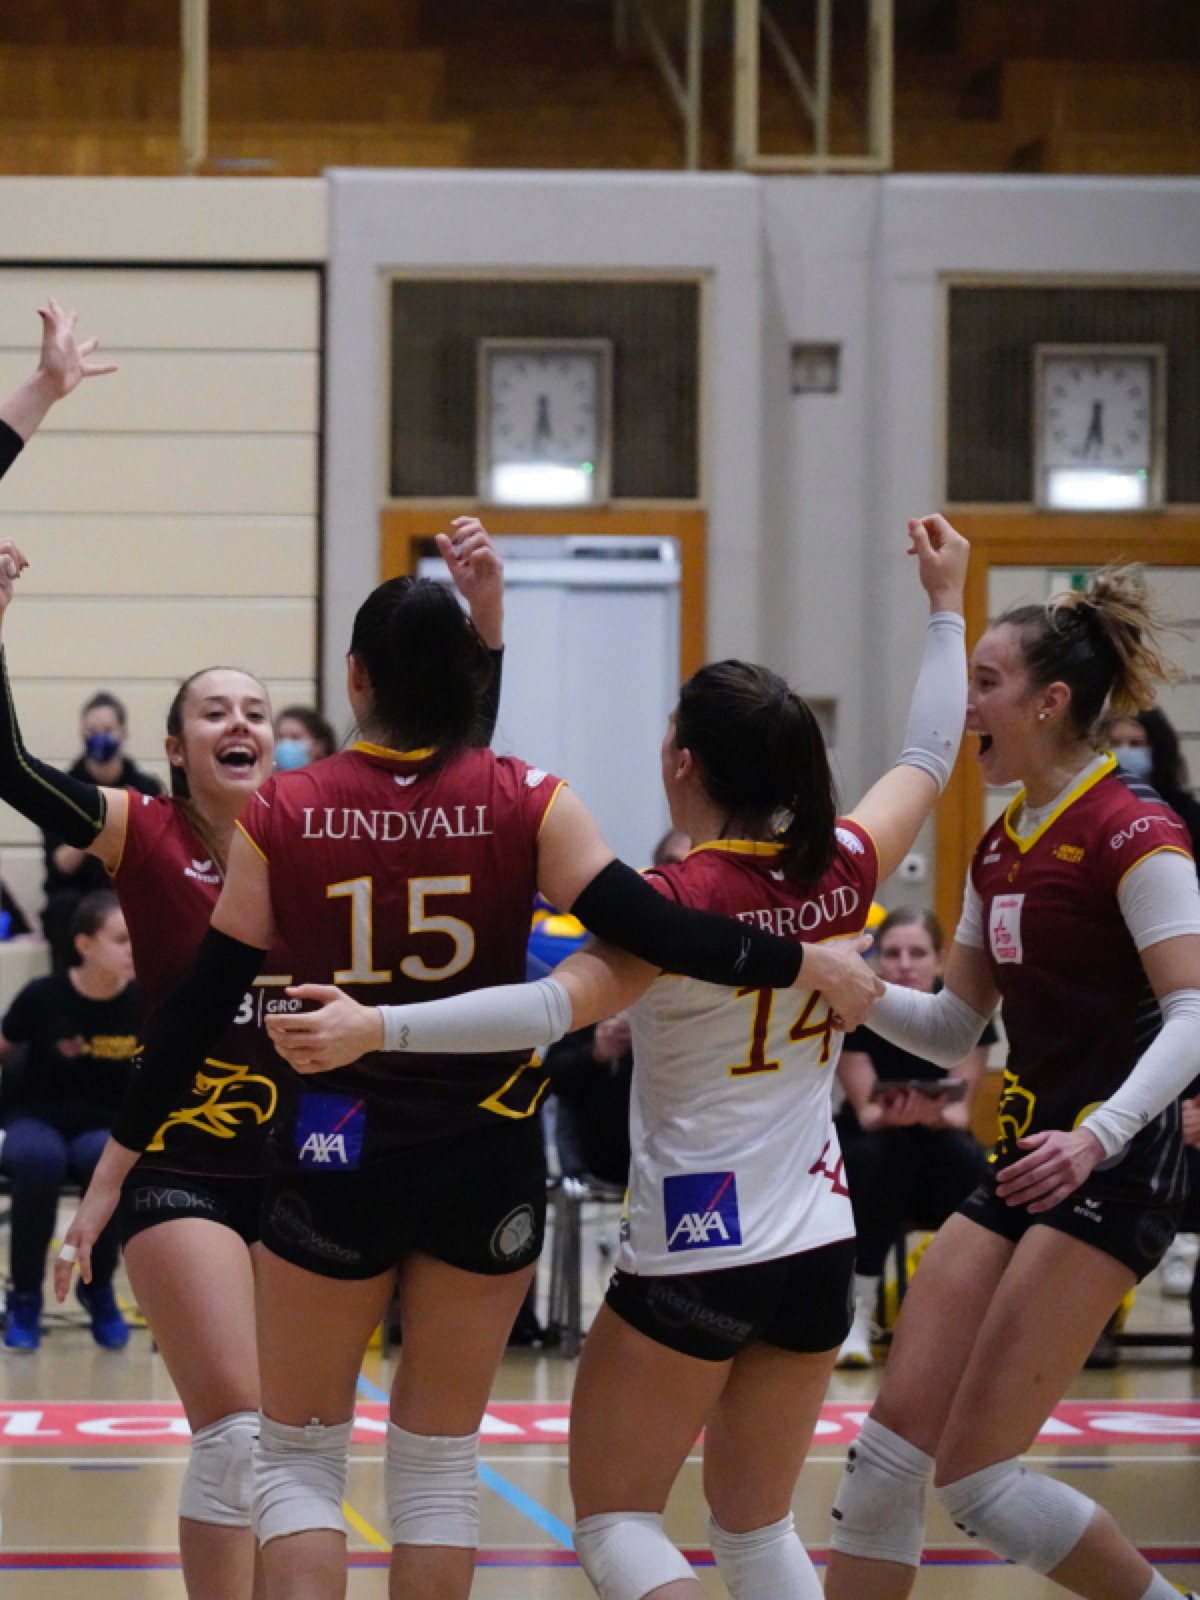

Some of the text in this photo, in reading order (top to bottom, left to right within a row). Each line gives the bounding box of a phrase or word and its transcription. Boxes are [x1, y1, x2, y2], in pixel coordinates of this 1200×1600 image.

[302, 804, 493, 842] LUNDVALL
[326, 875, 476, 985] 15
[728, 986, 835, 1079] 14
[298, 1131, 349, 1164] AXA
[668, 1210, 730, 1246] AXA
